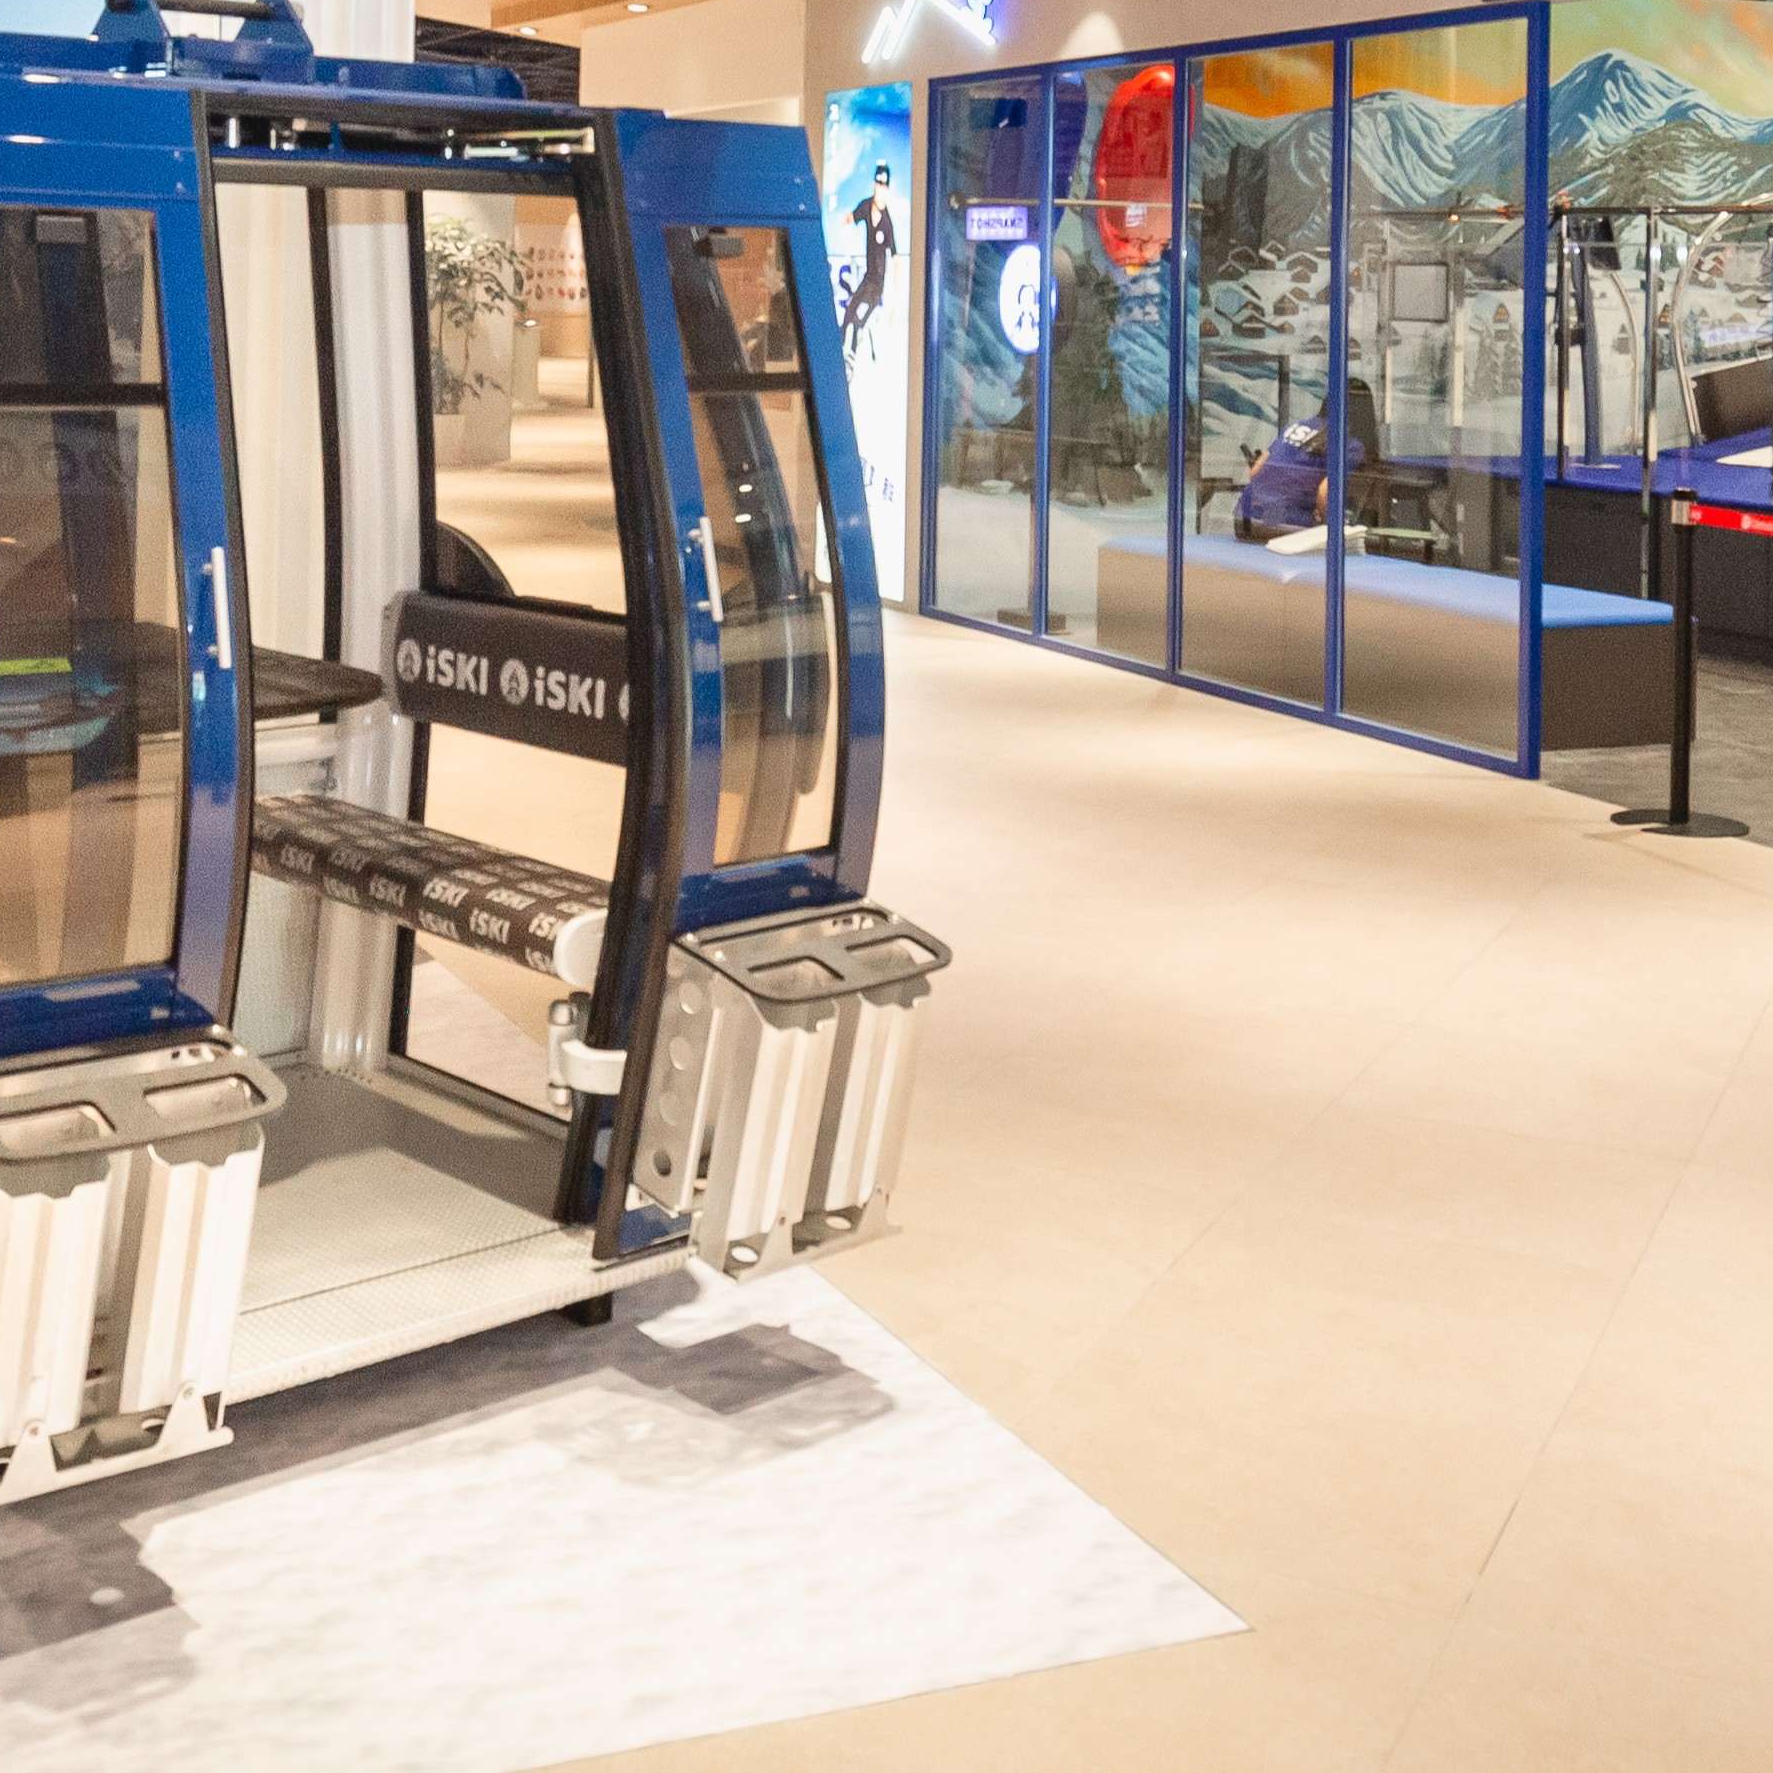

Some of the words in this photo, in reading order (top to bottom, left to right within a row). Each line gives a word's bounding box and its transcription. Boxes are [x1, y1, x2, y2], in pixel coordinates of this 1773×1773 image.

[426, 643, 489, 696] iSKI
[533, 665, 606, 720] iSKI
[469, 907, 511, 945] iSKI
